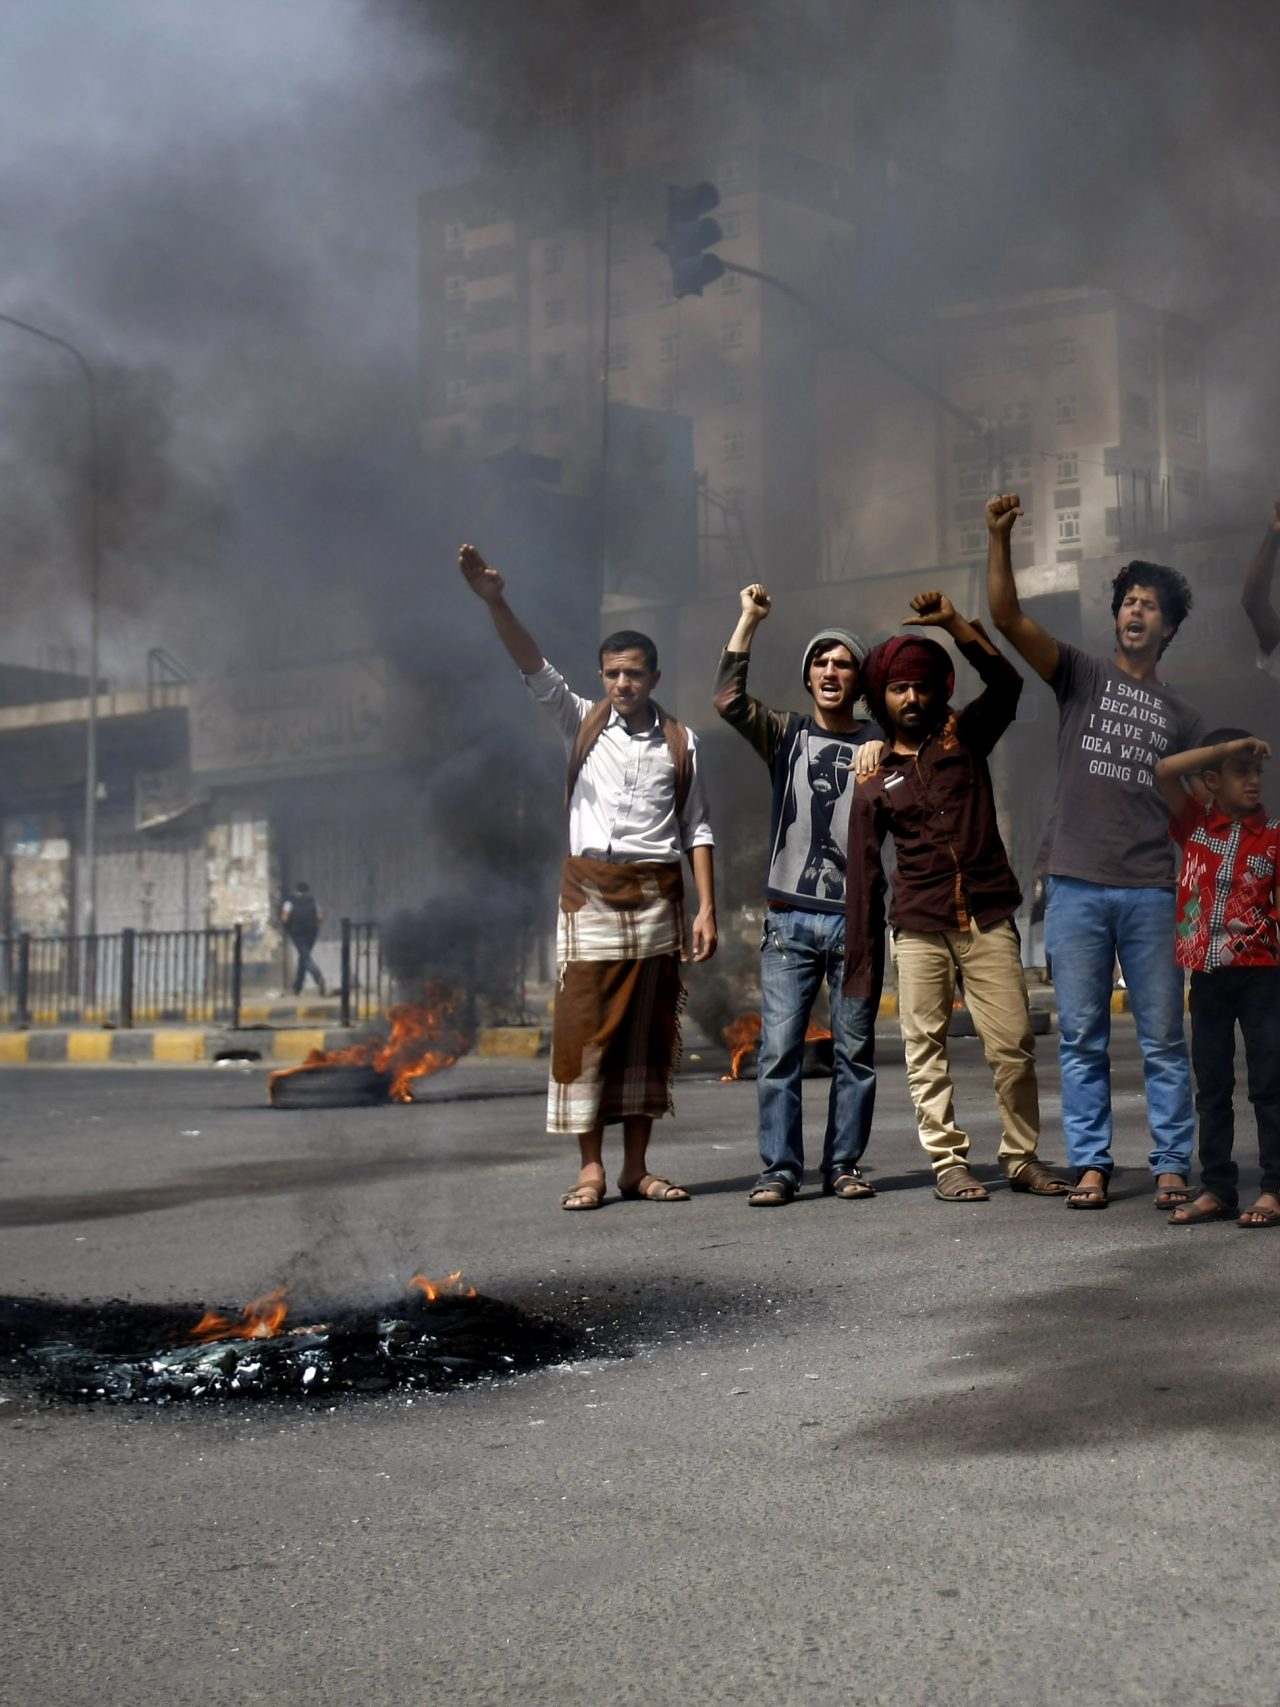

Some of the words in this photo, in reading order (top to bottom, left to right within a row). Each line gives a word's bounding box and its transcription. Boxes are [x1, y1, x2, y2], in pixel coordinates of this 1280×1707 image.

[1105, 680, 1112, 693] I
[1117, 683, 1163, 710] SMILE
[1100, 696, 1167, 729] BECAUSE
[1081, 734, 1112, 754] IDEA
[1089, 713, 1096, 728] I
[1101, 718, 1144, 741] HAVE
[1149, 731, 1168, 752] NO
[1089, 759, 1131, 782] GOING
